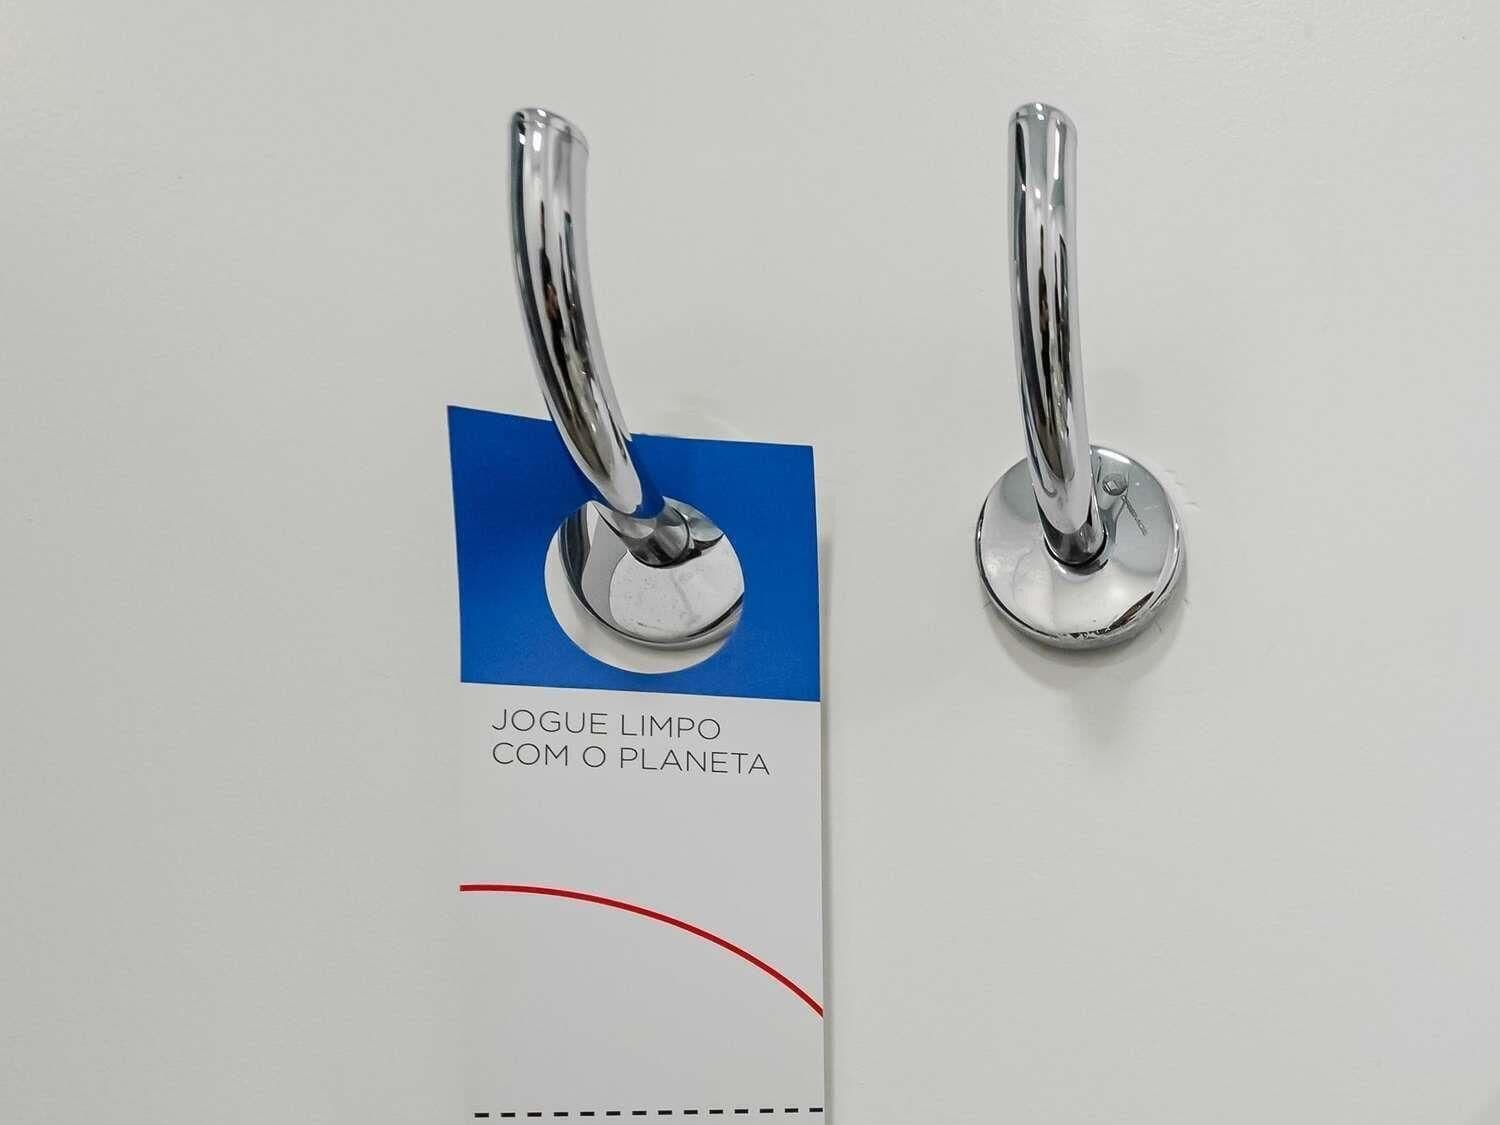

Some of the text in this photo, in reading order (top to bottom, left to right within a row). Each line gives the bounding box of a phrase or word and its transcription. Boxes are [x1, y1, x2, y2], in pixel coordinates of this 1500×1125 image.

[491, 708, 721, 741] JOGUE LIMPO
[492, 742, 770, 776] COM O PLANETA
